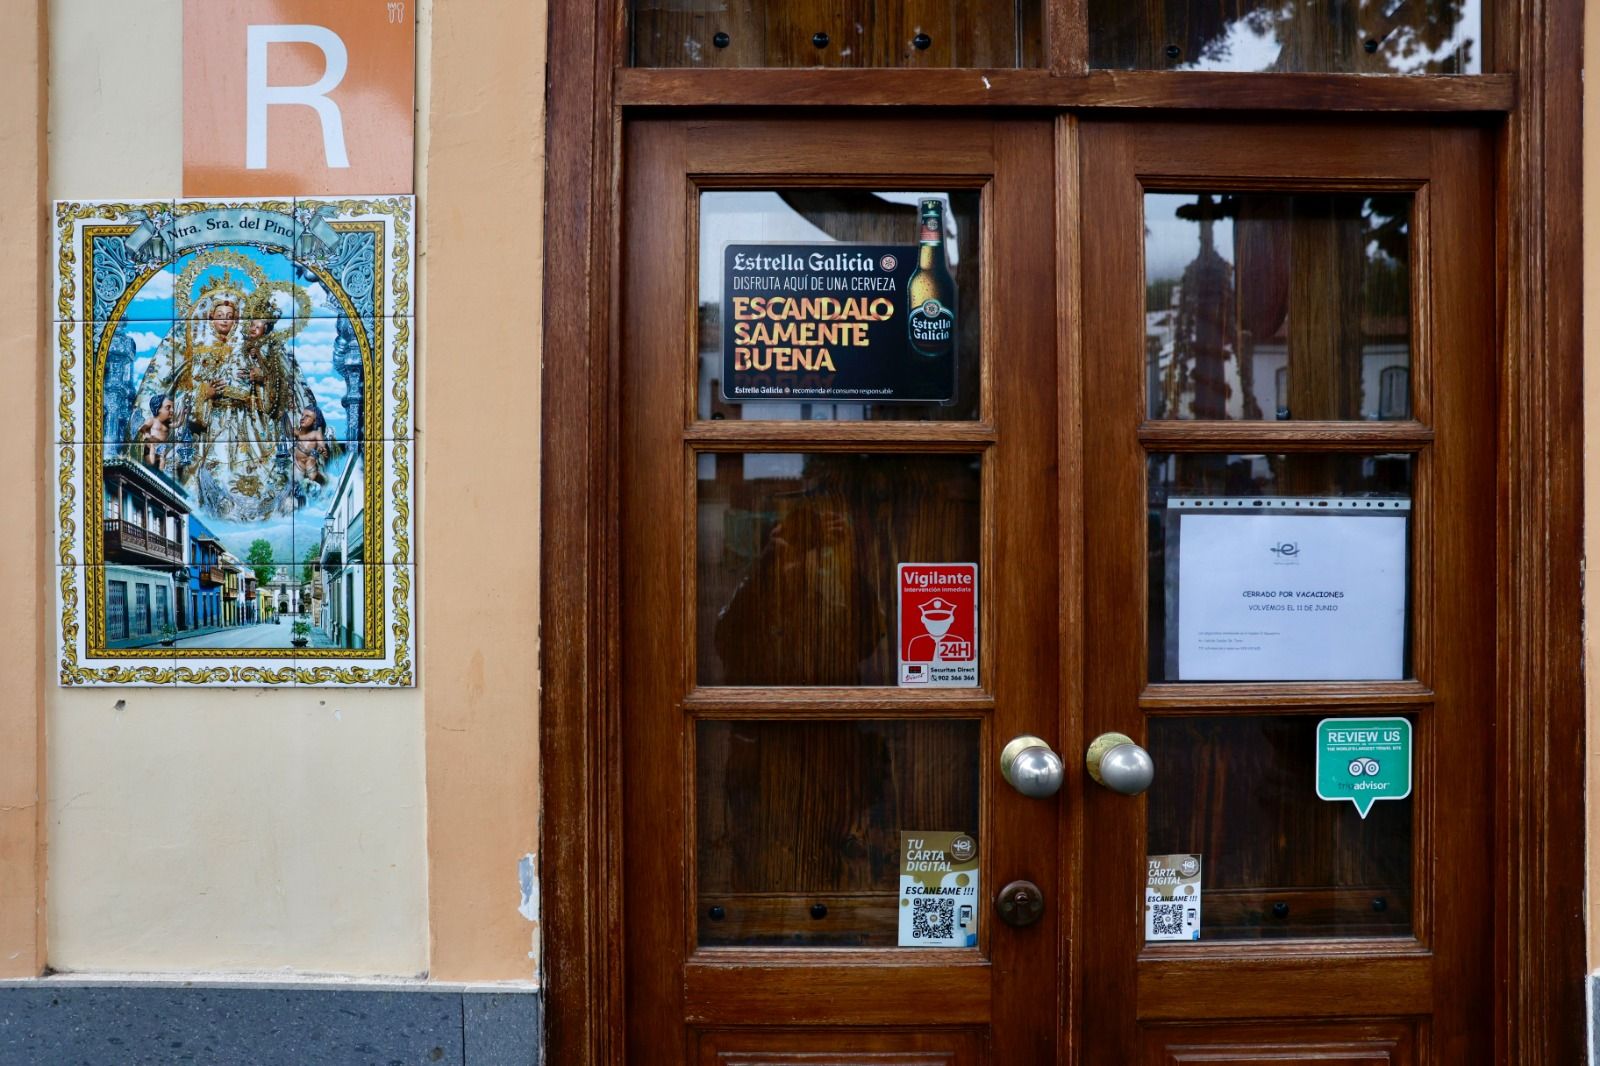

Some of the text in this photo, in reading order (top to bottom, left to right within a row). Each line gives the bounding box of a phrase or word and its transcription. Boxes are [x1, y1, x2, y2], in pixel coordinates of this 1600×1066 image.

[246, 24, 350, 169] R
[167, 216, 294, 241] Ntra. Sra. del Pino
[733, 252, 874, 272] Estrella Galicia
[733, 274, 896, 292] DISFRUTA AQUÍ DE UNA CERVEZA
[733, 296, 894, 321] ESCANDALO
[912, 317, 951, 330] Estrella
[734, 322, 870, 347] SAMENTE
[913, 328, 949, 341] Galicia
[734, 347, 837, 372] BUENA
[734, 386, 760, 394] Estrella
[760, 386, 783, 394] Galicia
[859, 388, 894, 396] responsable
[904, 571, 972, 588] Vigilante
[1248, 604, 1285, 612] VOLVEMOS
[1287, 604, 1295, 612] EL
[1304, 604, 1313, 612] DE
[1314, 604, 1338, 612] JUNIO
[940, 643, 969, 657] 24H
[1328, 731, 1400, 743] REVIEW US
[908, 839, 924, 850] TU
[906, 850, 944, 861] CARTA
[906, 861, 952, 872] DIGITAL
[1149, 861, 1161, 869] TU
[1148, 868, 1176, 877] CARTA
[1148, 876, 1181, 886] DIGITAL
[905, 886, 974, 896] ESCANEAME !!!
[1147, 895, 1188, 903] ESCANEAME
